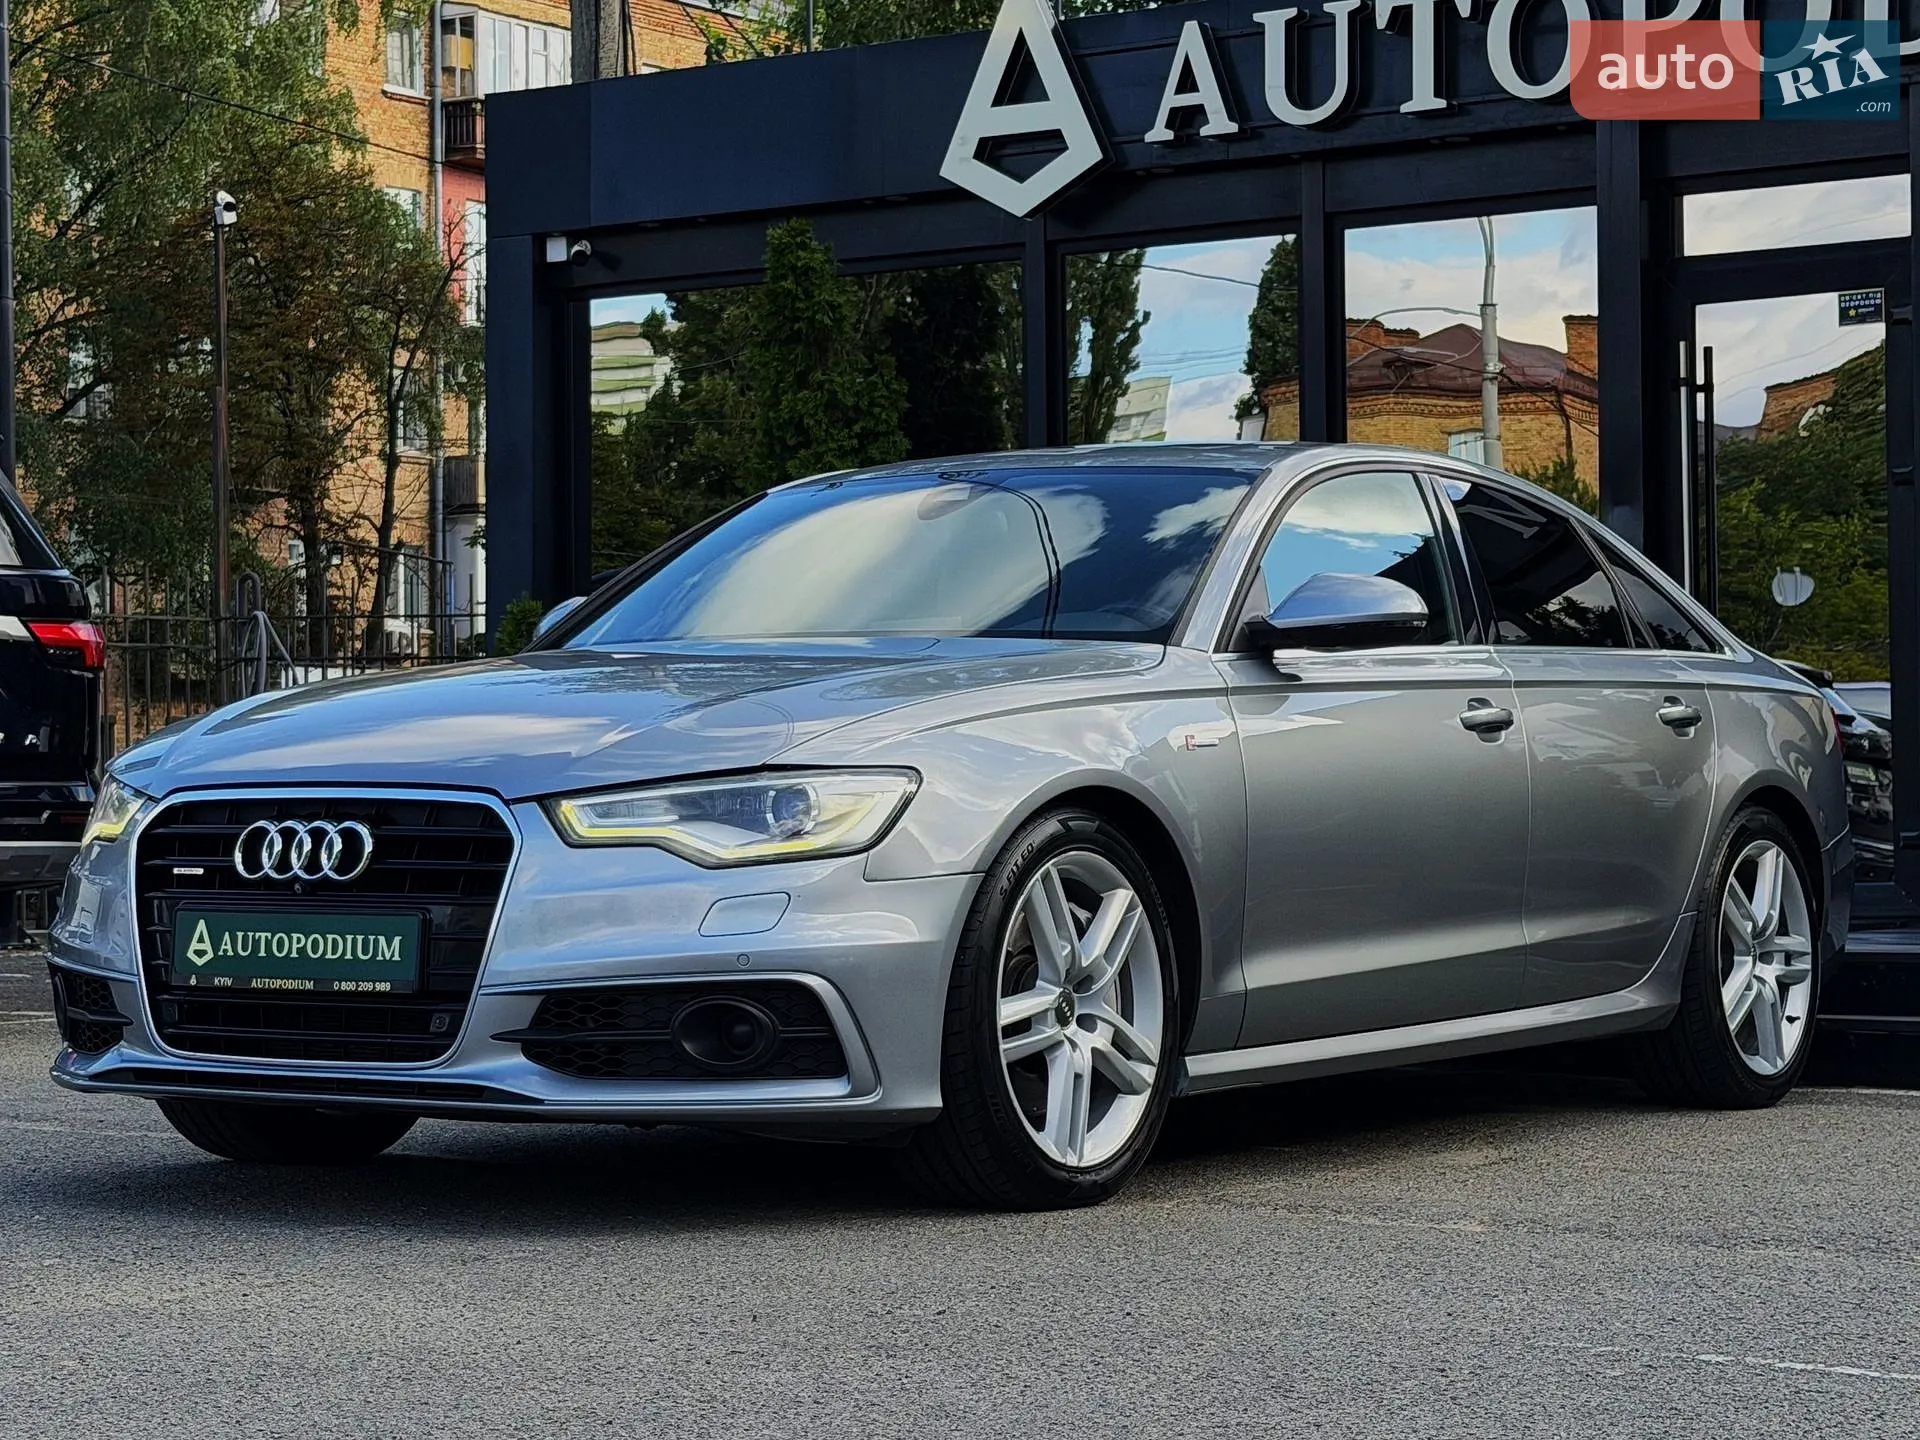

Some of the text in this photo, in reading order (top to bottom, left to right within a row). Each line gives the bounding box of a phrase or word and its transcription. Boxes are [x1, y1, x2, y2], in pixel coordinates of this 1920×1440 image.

[218, 931, 402, 962] AUTOPODIUM
[214, 976, 391, 992] KYIV AUTOPODIUM 0 800 209 989
